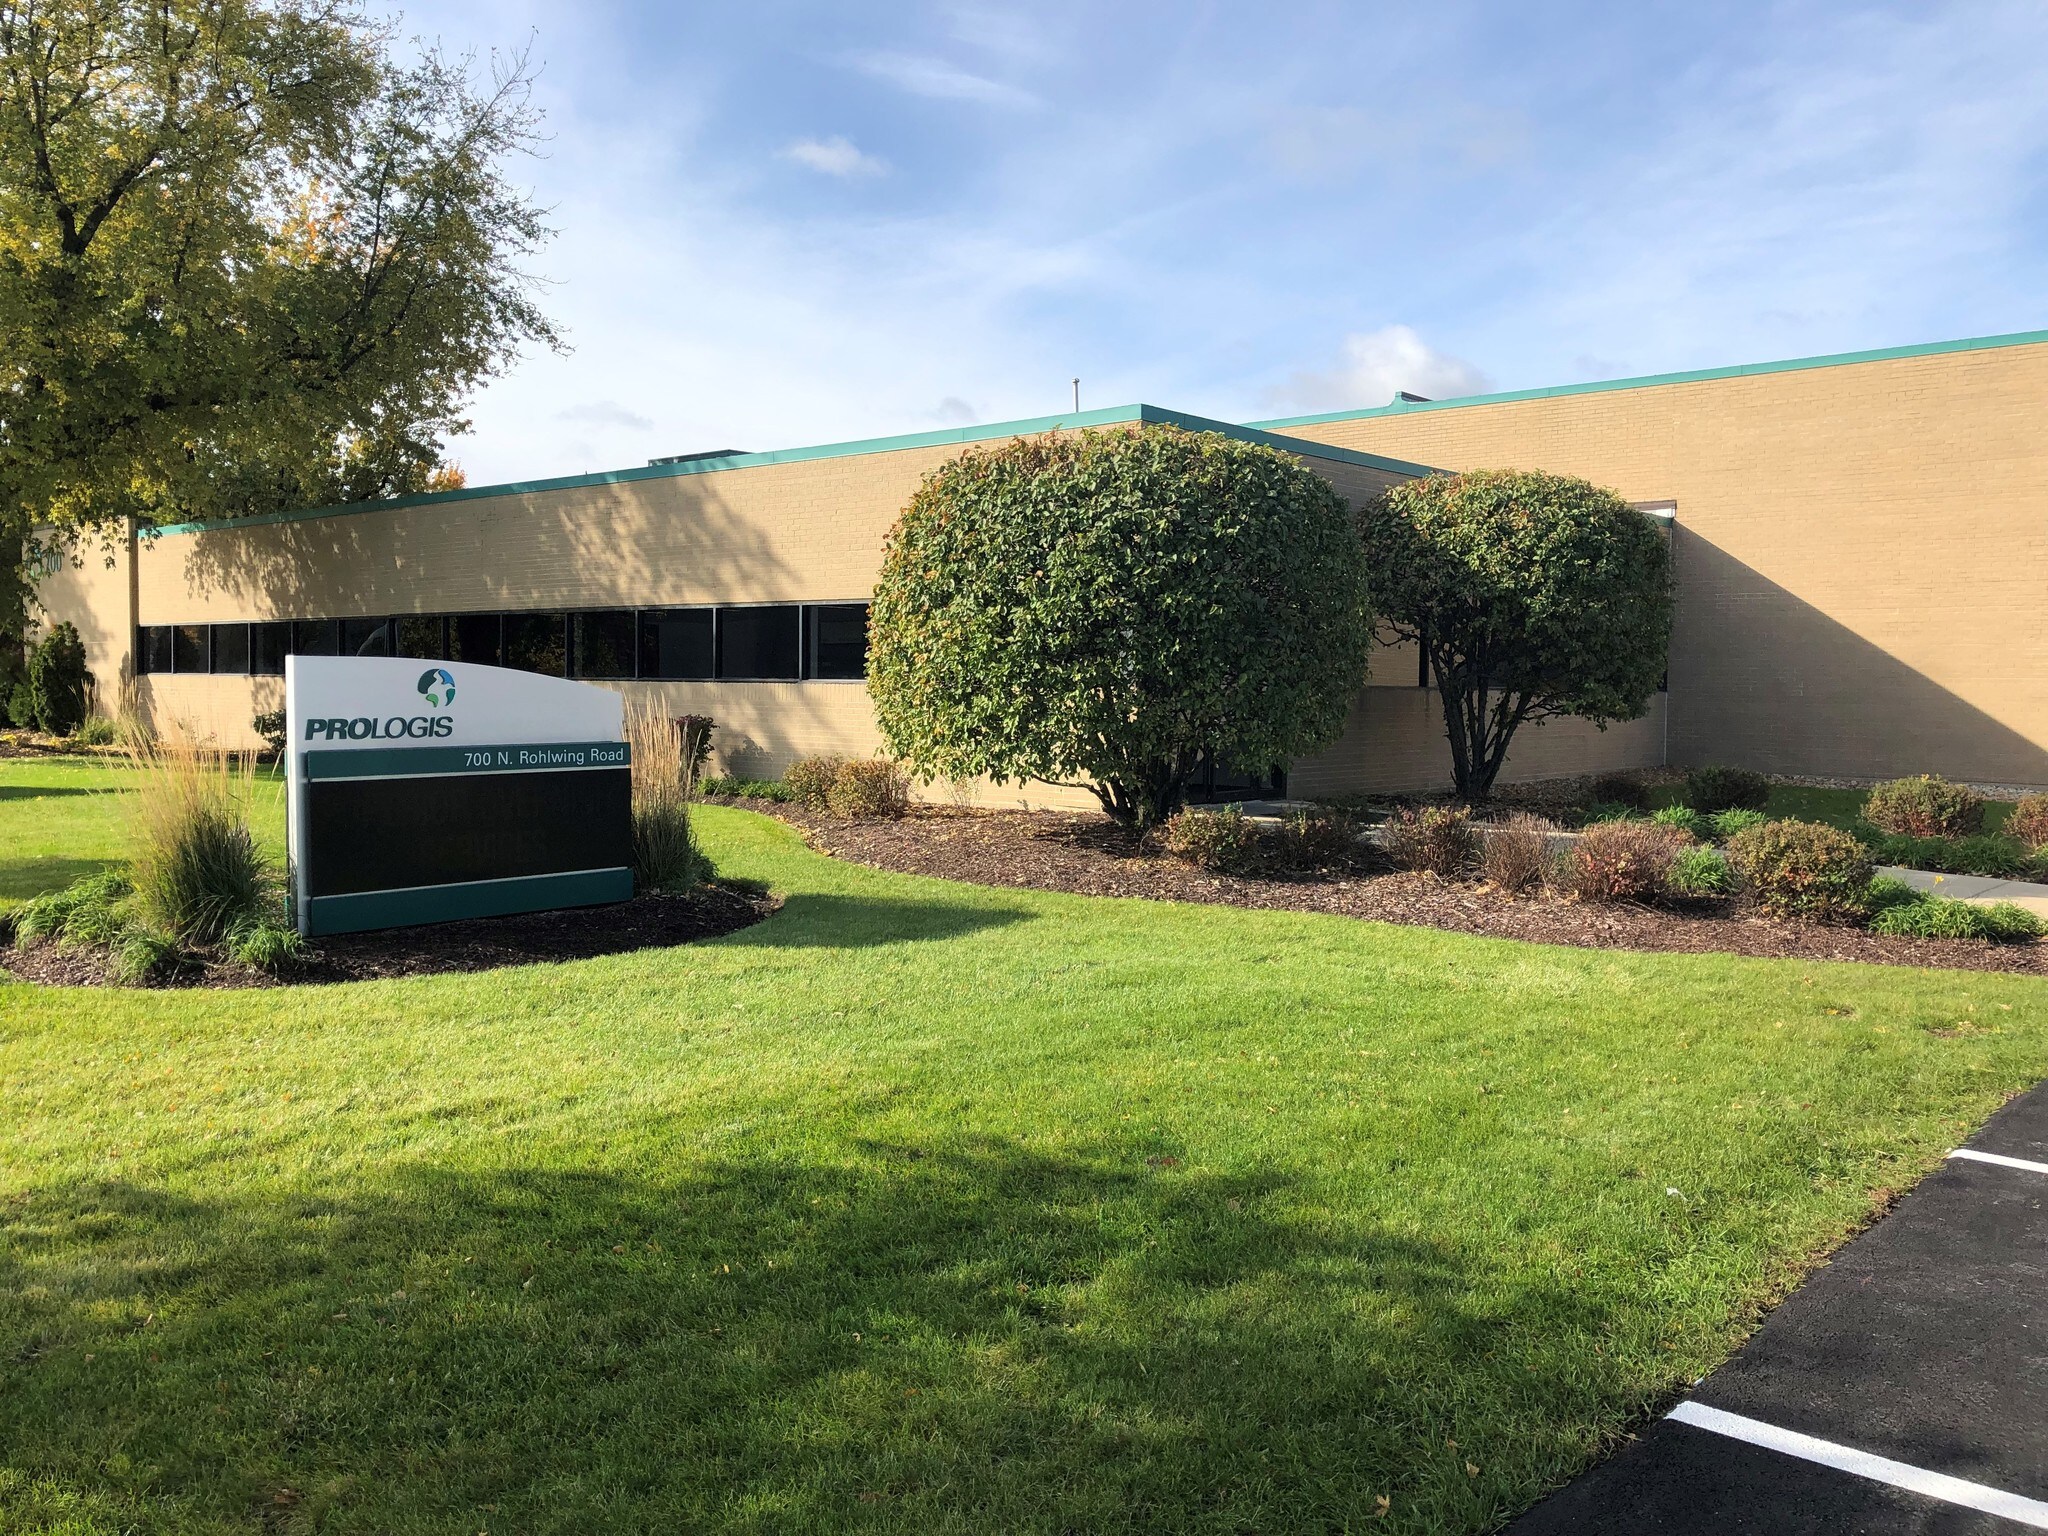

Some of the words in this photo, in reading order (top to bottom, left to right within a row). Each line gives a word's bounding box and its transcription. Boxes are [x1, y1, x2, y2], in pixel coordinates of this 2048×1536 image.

[305, 716, 454, 741] PROLOGIS
[464, 752, 491, 767] 700
[498, 751, 513, 765] N.
[519, 749, 585, 766] Rohlwing
[590, 748, 624, 762] Road
